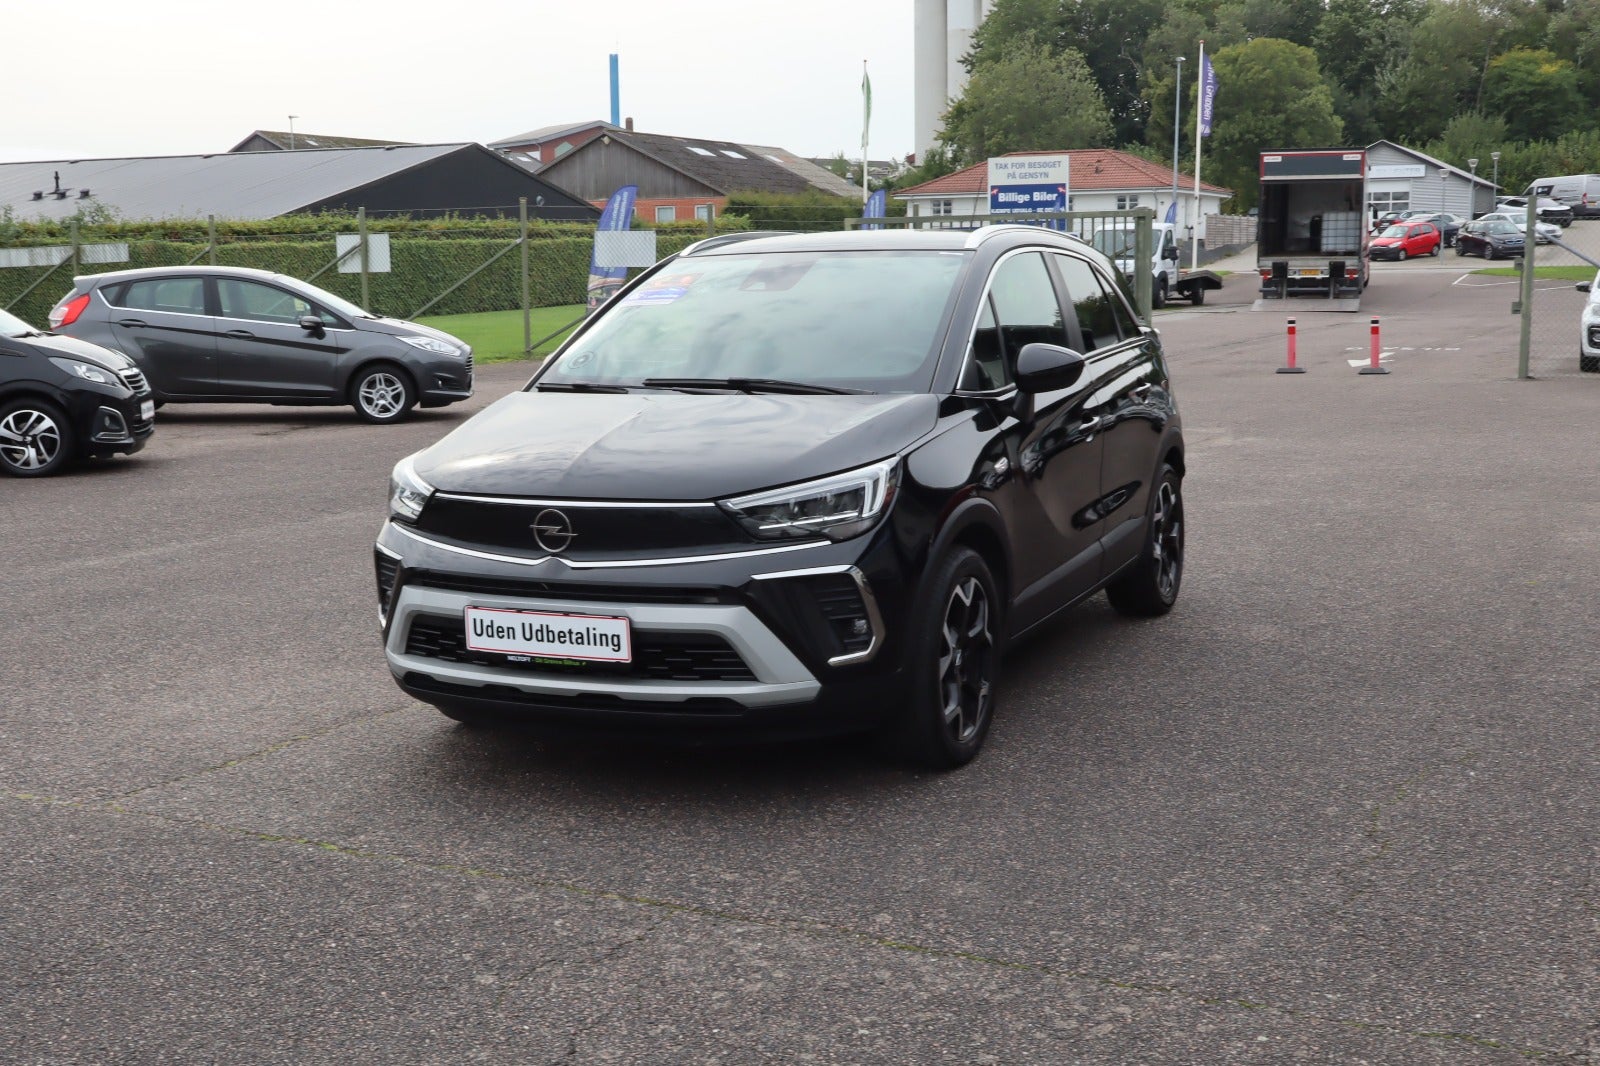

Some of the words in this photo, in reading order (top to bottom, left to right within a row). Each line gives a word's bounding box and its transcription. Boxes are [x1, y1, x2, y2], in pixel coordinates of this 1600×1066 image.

[995, 162, 1009, 170] TAK
[1011, 162, 1026, 170] FOR
[1028, 160, 1062, 169] BESØGET
[1007, 172, 1017, 180] PÅ
[1019, 171, 1049, 179] GENSYN
[998, 192, 1030, 204] Billige
[1033, 191, 1058, 201] Biler
[473, 617, 516, 640] Uden
[522, 622, 621, 652] Udbetaling
